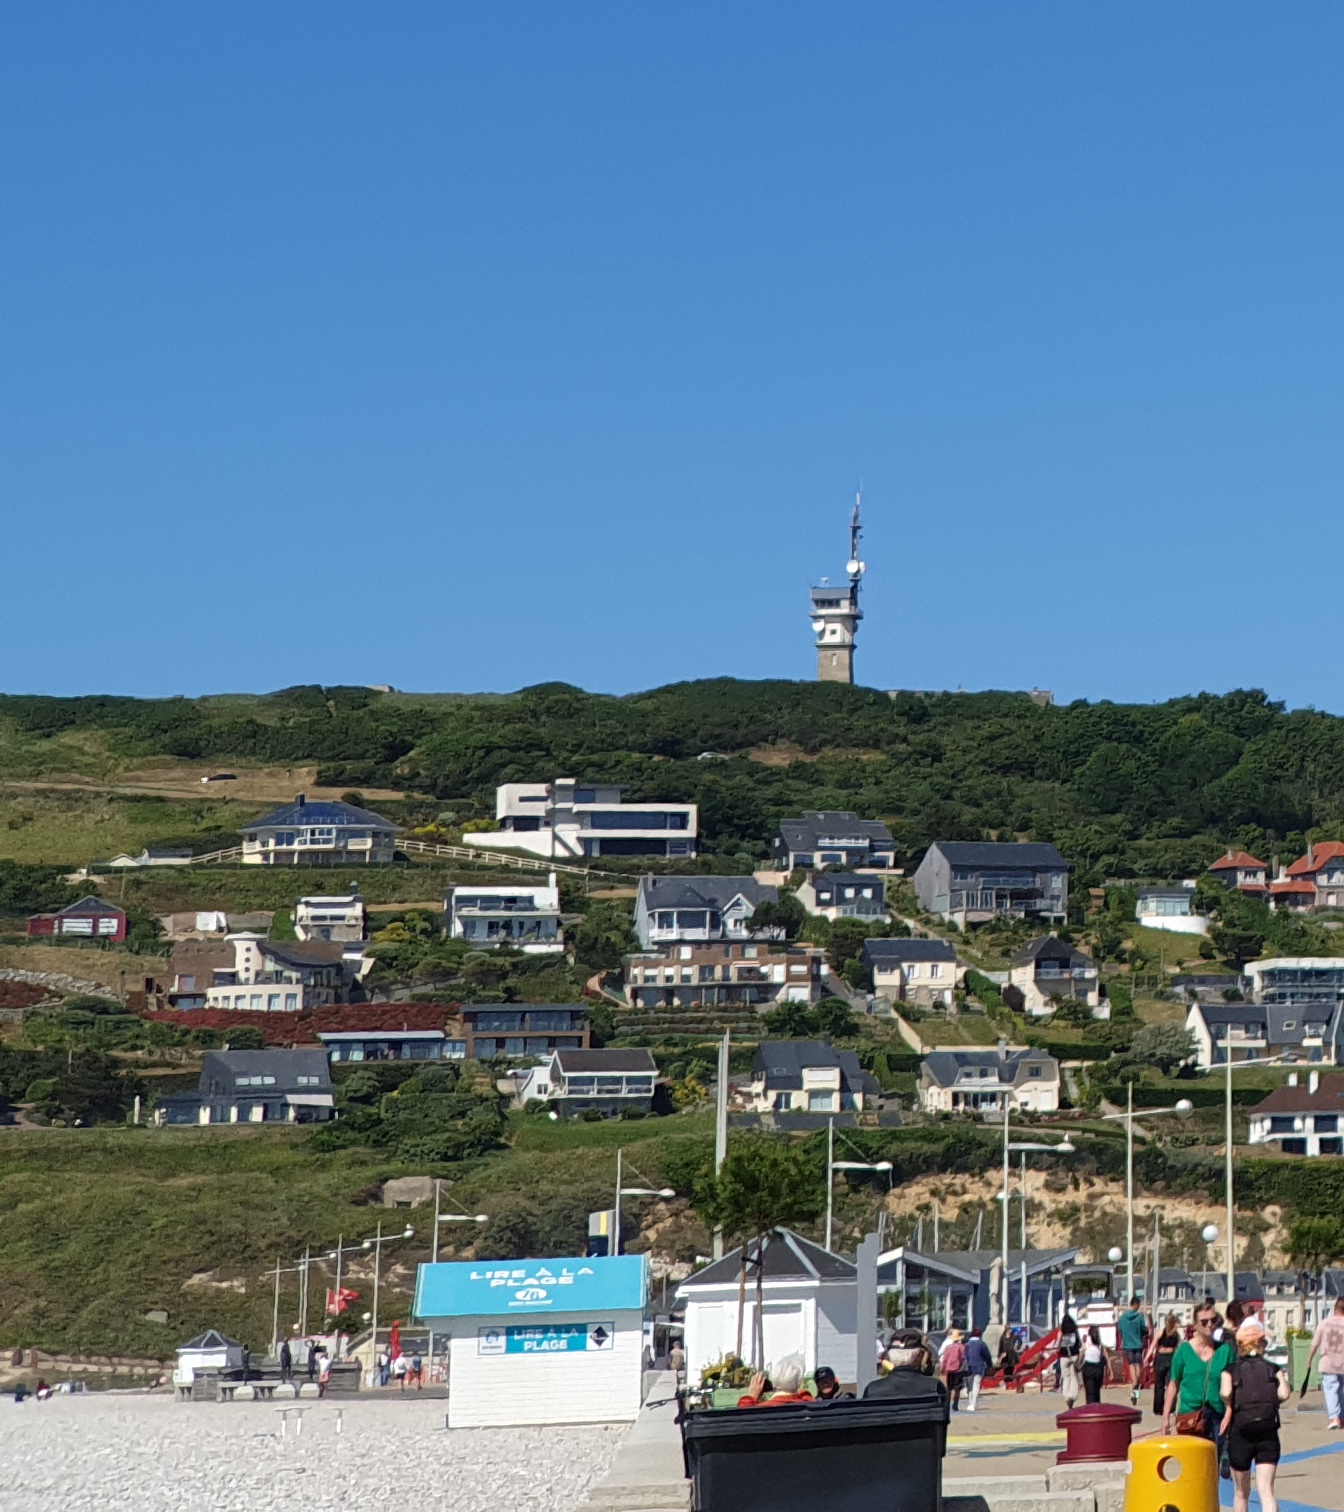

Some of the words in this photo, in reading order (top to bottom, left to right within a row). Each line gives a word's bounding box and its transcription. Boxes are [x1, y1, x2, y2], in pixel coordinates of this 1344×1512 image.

[470, 1271, 526, 1279] LIRE
[562, 1267, 594, 1276] LA
[490, 1276, 574, 1287] PLAGE
[514, 1329, 543, 1339] LIRE
[561, 1328, 579, 1338] LA
[524, 1340, 568, 1351] PLAGE
